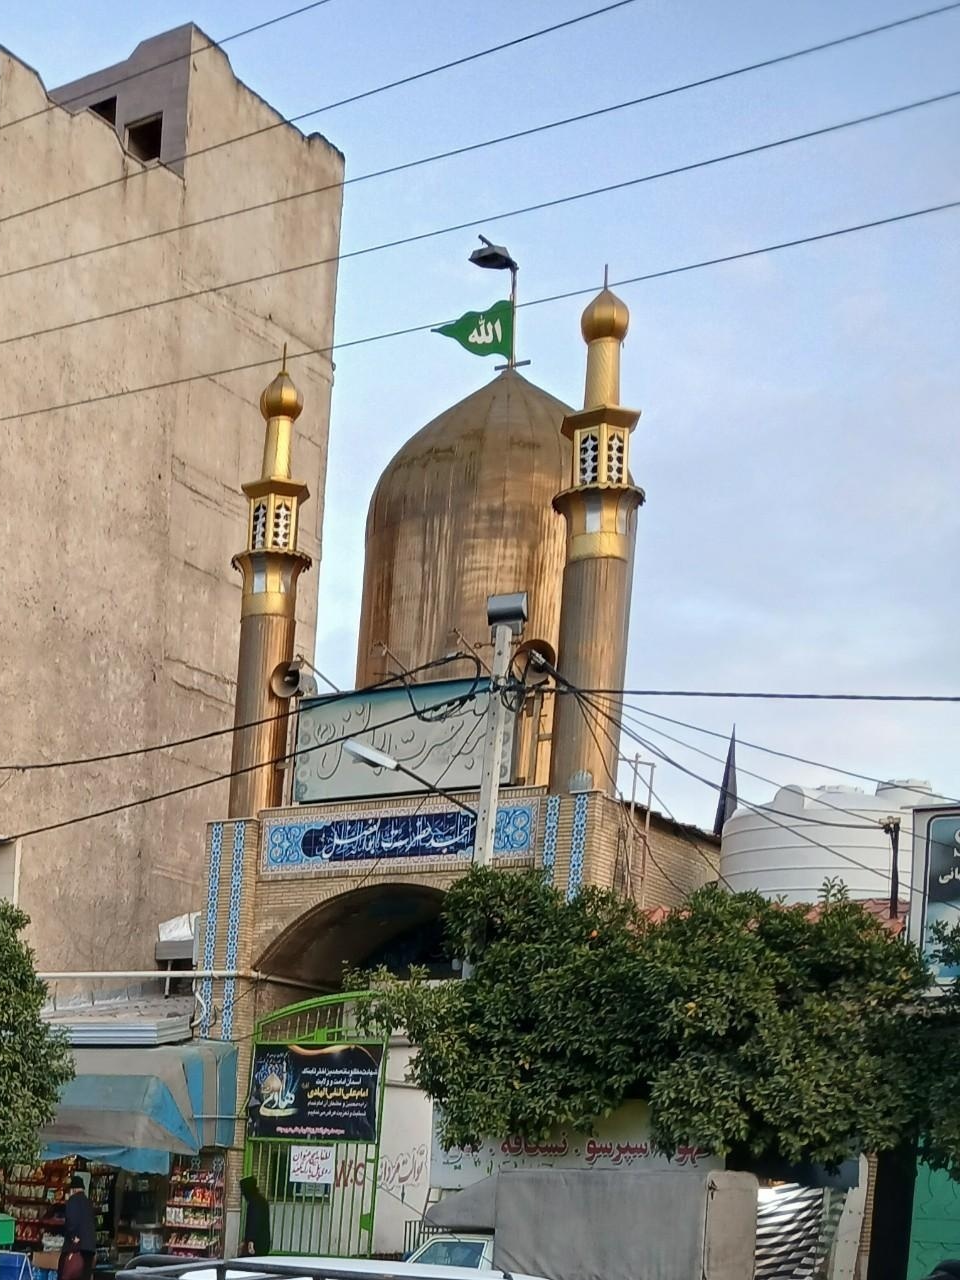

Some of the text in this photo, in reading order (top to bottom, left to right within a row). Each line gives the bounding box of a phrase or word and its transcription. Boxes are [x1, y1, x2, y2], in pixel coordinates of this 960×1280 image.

[468, 314, 502, 344] الله
[307, 1086, 326, 1099] الهادی
[342, 1087, 356, 1099] علی
